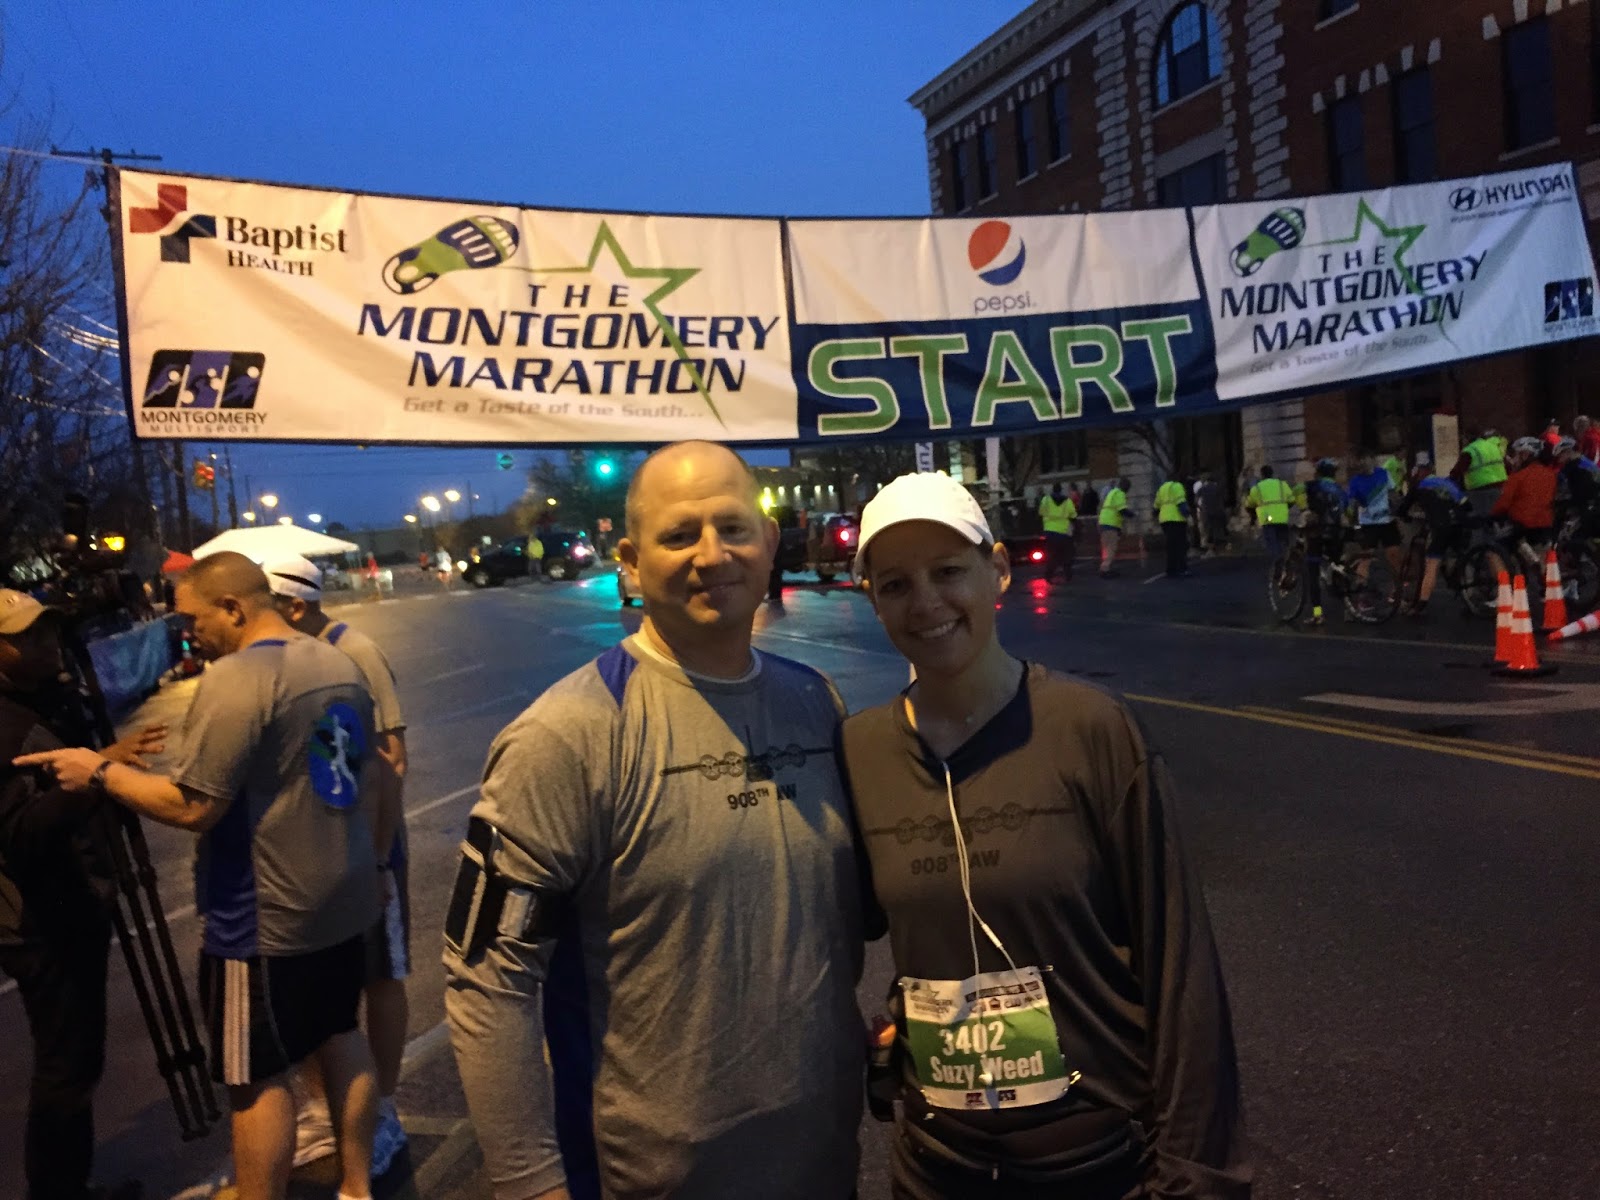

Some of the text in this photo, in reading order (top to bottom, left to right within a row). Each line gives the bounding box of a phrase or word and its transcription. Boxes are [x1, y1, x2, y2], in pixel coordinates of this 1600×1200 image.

[1486, 174, 1572, 204] HYUNDAI
[224, 216, 348, 256] Baptist
[227, 250, 314, 277] HEALTH
[1319, 245, 1386, 273] THE
[528, 284, 630, 308] THE
[1220, 250, 1488, 318] MONTGOMERY
[974, 290, 1031, 315] pepsi
[357, 303, 780, 351] MONTGOMERY
[1253, 291, 1464, 354] MARATHON
[408, 351, 746, 395] MARATHON
[807, 314, 1193, 436] START
[141, 410, 268, 424] MONTGOMERY
[403, 398, 446, 413] Get
[454, 401, 469, 413] a
[479, 397, 541, 415] Taste
[548, 401, 569, 415] of
[579, 403, 615, 417] the
[150, 424, 260, 433] MULTISPORT
[940, 1020, 1006, 1056] 3402
[930, 1050, 1045, 1090] Suzy Weed
